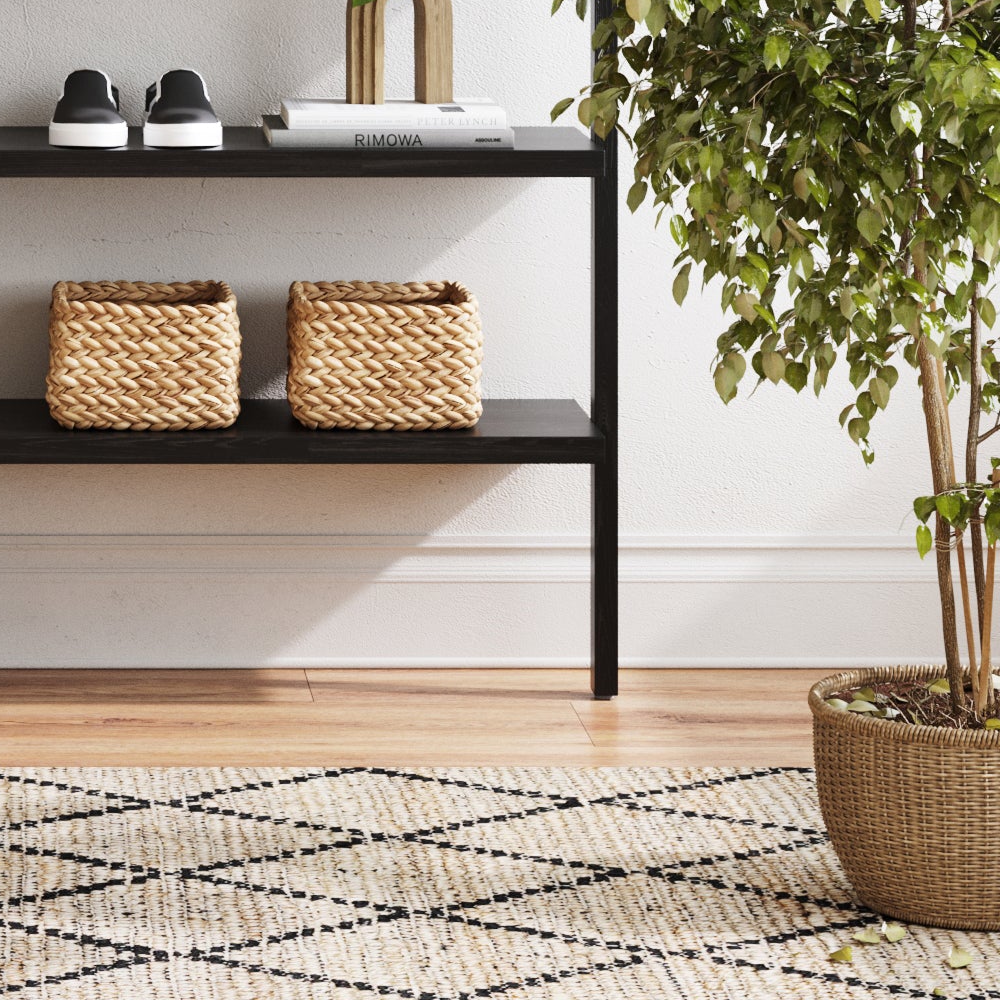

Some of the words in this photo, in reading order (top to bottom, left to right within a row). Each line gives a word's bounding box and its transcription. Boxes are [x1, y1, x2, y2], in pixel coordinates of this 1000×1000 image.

[417, 118, 455, 126] PETER
[459, 118, 497, 126] LYNCH
[355, 134, 423, 146] RIMOWA
